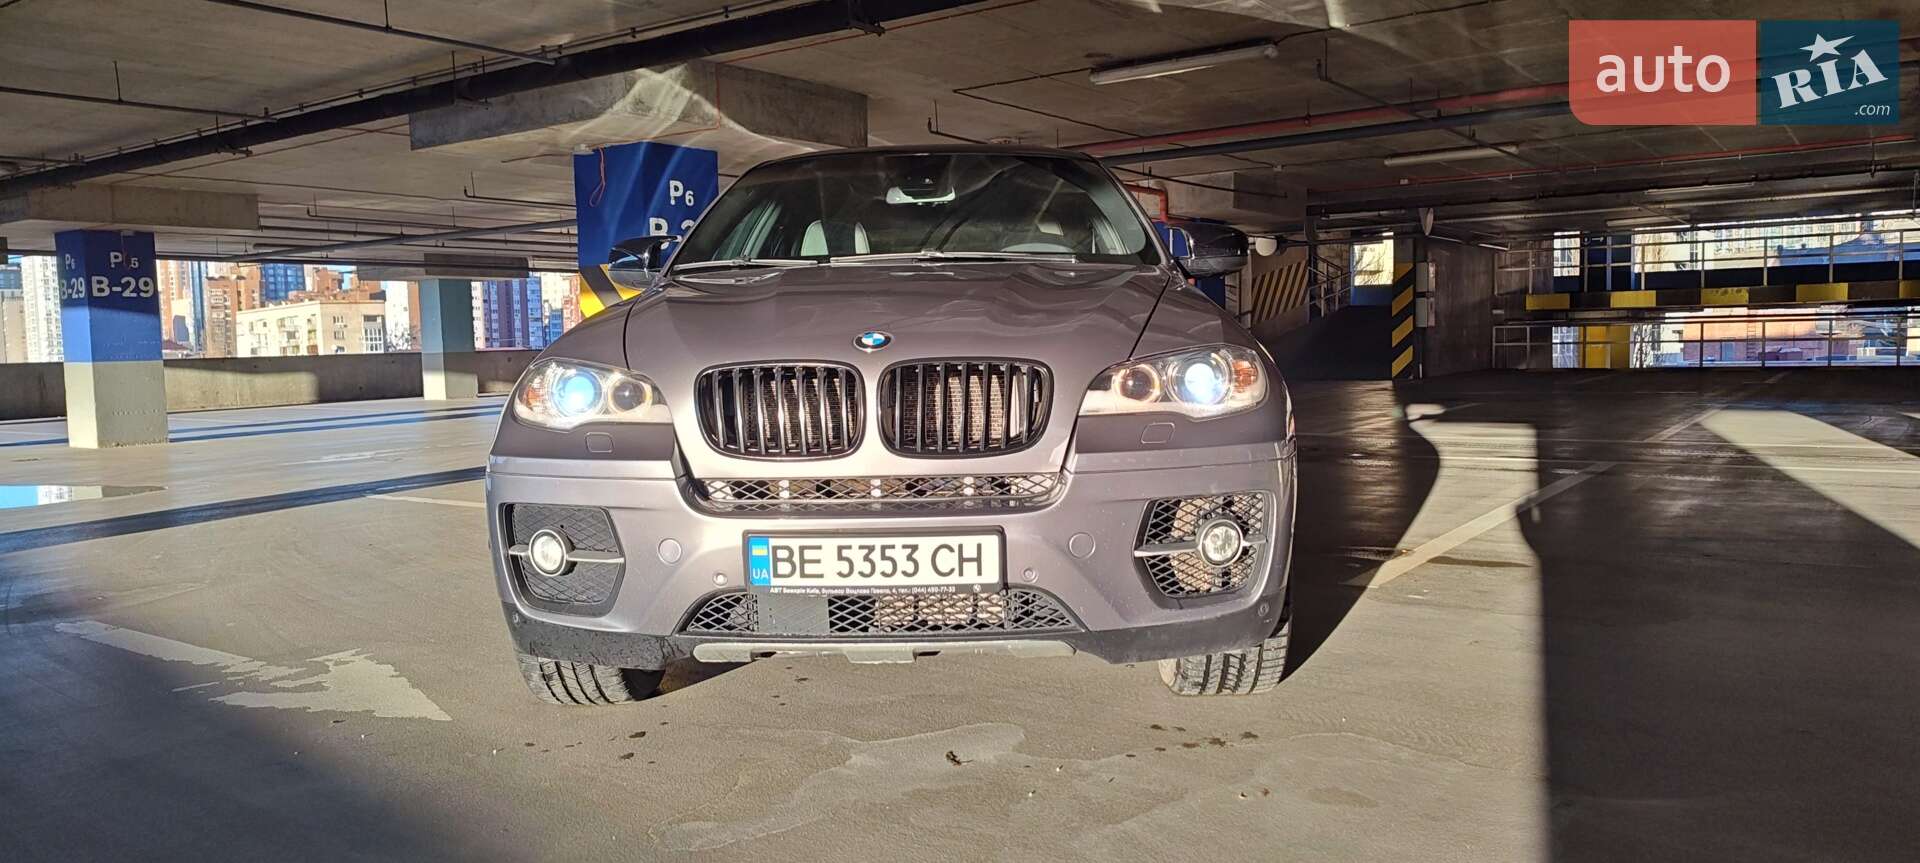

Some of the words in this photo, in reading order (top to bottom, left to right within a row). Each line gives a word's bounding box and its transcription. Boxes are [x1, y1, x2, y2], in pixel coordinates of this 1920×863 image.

[60, 277, 86, 299] B-29
[91, 276, 154, 298] B-29
[771, 545, 824, 579] BE
[836, 544, 920, 578] 5353
[930, 543, 983, 577] CH
[752, 568, 769, 580] UA
